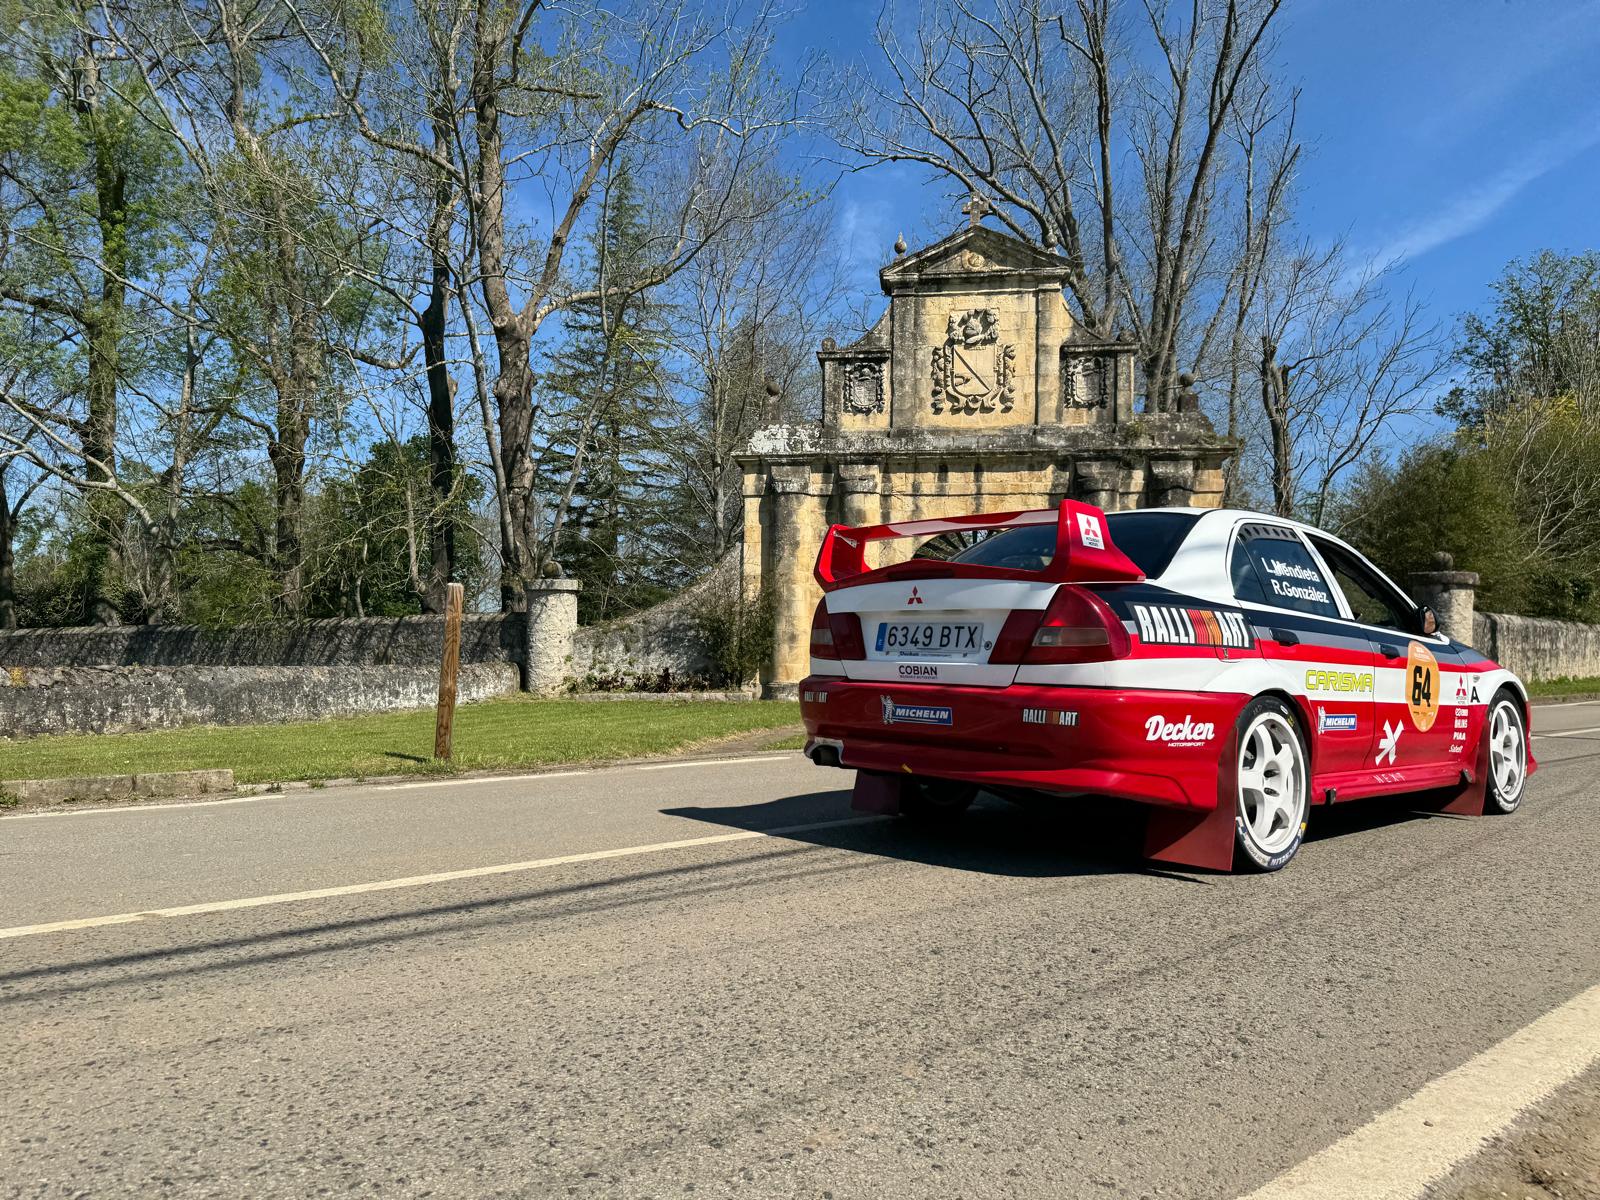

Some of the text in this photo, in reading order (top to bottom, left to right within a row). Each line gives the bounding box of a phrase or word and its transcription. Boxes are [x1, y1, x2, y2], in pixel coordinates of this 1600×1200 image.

[1261, 557, 1320, 582] L.Mendieta
[1271, 579, 1330, 603] R.González
[887, 625, 934, 647] 6349
[939, 625, 978, 648] BTX
[1134, 605, 1250, 648] RALLI ART
[898, 665, 938, 676] COBIAN
[1305, 669, 1373, 692] CARISMA
[1412, 665, 1431, 707] 64
[1470, 686, 1480, 703] A
[895, 708, 949, 720] MICHELIN
[1022, 708, 1078, 726] RALLI ART
[1325, 717, 1356, 726] MICHELIN
[1145, 714, 1215, 741] Decken
